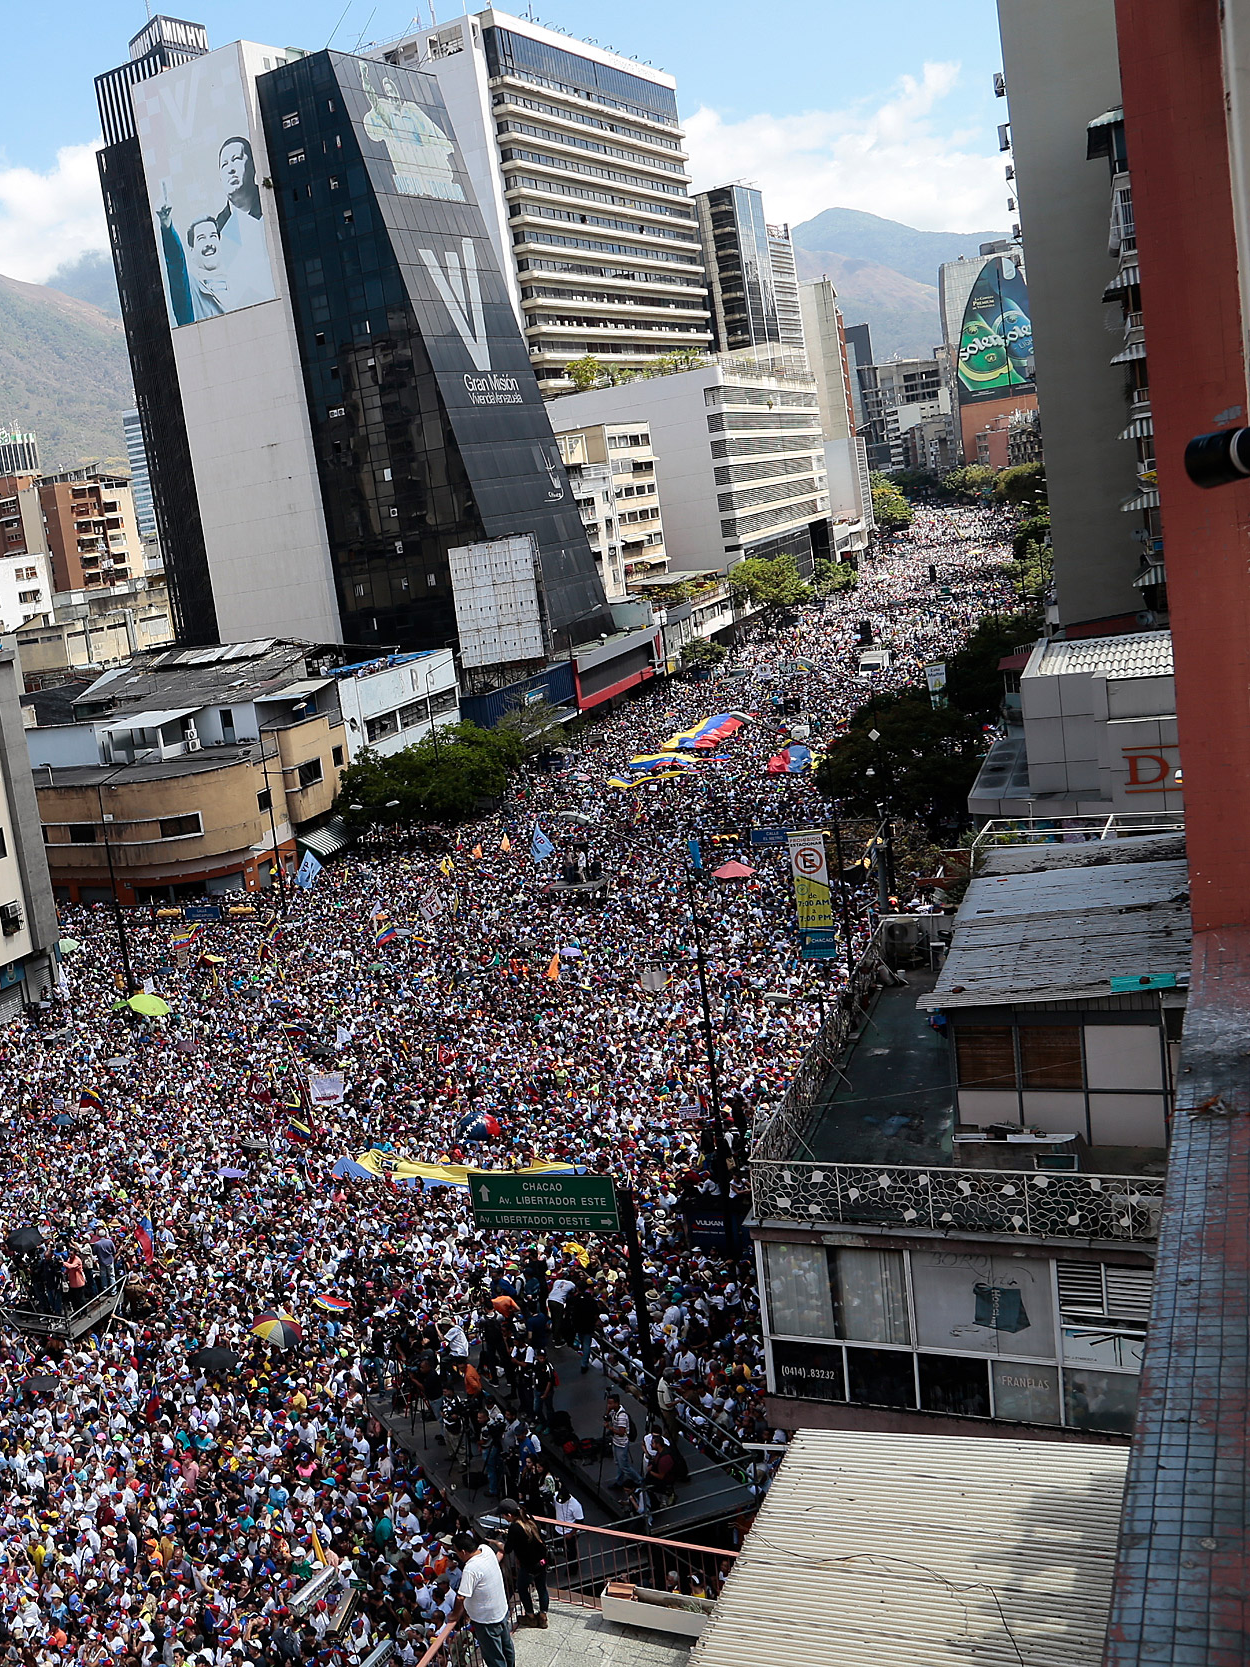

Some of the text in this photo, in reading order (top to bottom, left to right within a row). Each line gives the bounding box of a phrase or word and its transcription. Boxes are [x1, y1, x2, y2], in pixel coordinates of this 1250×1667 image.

[160, 20, 209, 50] MINHVI
[464, 373, 520, 391] Gran Misión
[522, 1182, 563, 1192] CHACAO
[499, 1196, 607, 1206] Av. LIBERTADOR ESTE
[479, 1215, 591, 1226] Av. LIBERTADOR OESTE
[695, 1219, 725, 1227] VULKAN
